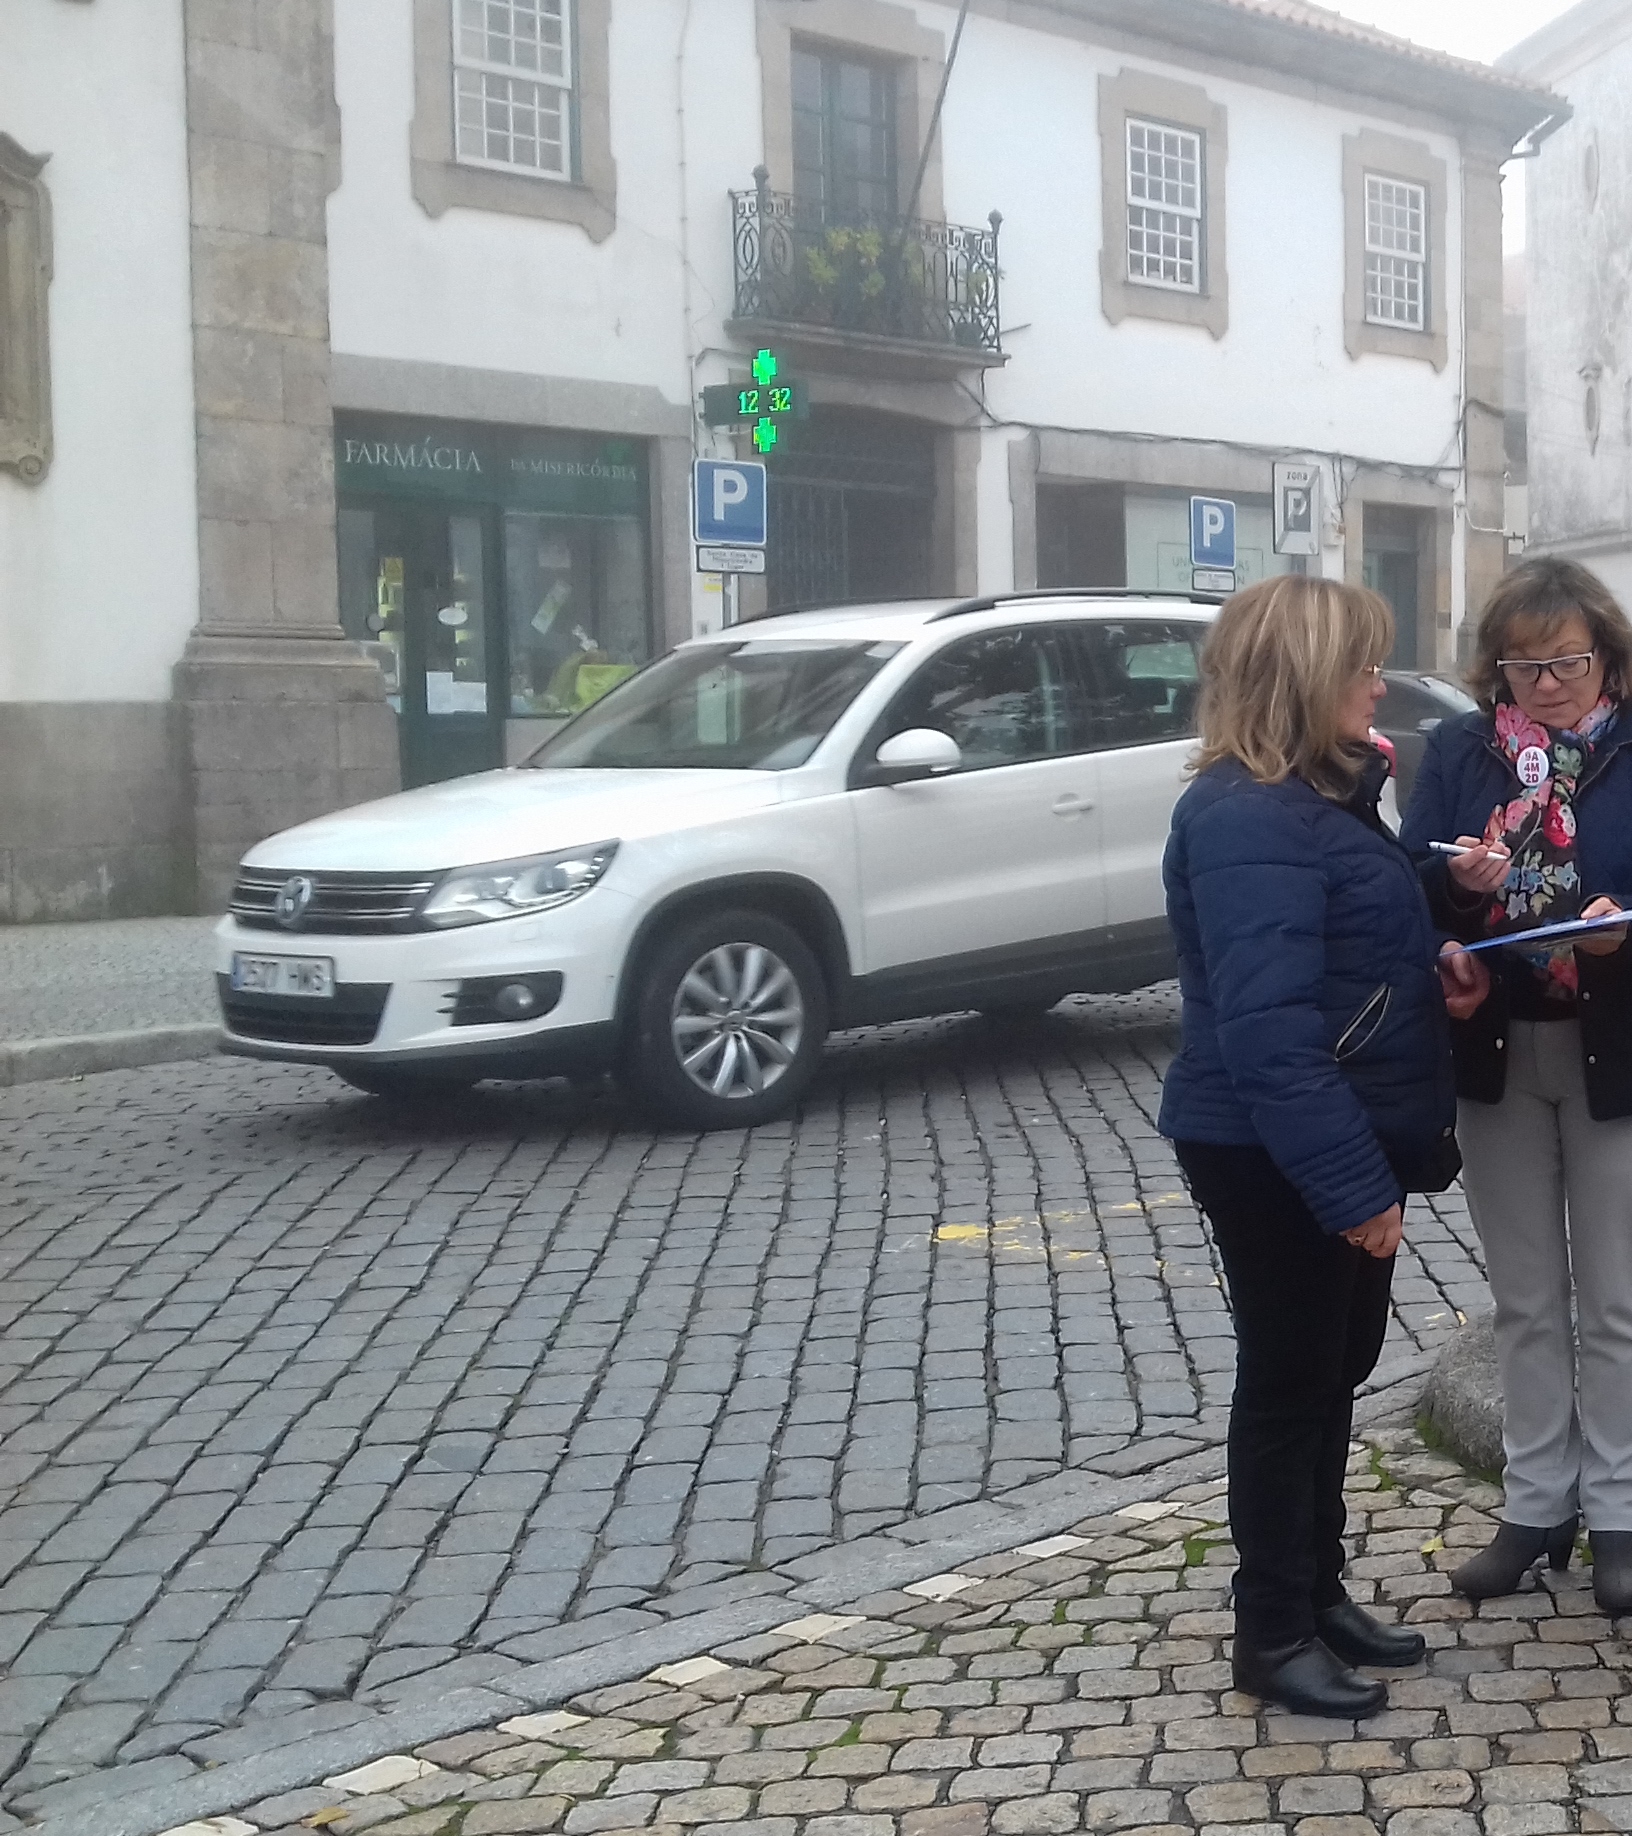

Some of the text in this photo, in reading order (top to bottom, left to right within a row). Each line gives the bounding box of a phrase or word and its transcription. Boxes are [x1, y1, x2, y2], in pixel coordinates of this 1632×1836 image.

[738, 387, 790, 413] 12 32
[345, 435, 482, 473] FARMÁCIA
[531, 457, 637, 480] MISERICÓRDIA
[713, 468, 748, 521] P
[1202, 504, 1225, 548] P
[1523, 762, 1540, 772] 4M
[1525, 773, 1539, 783] 2D
